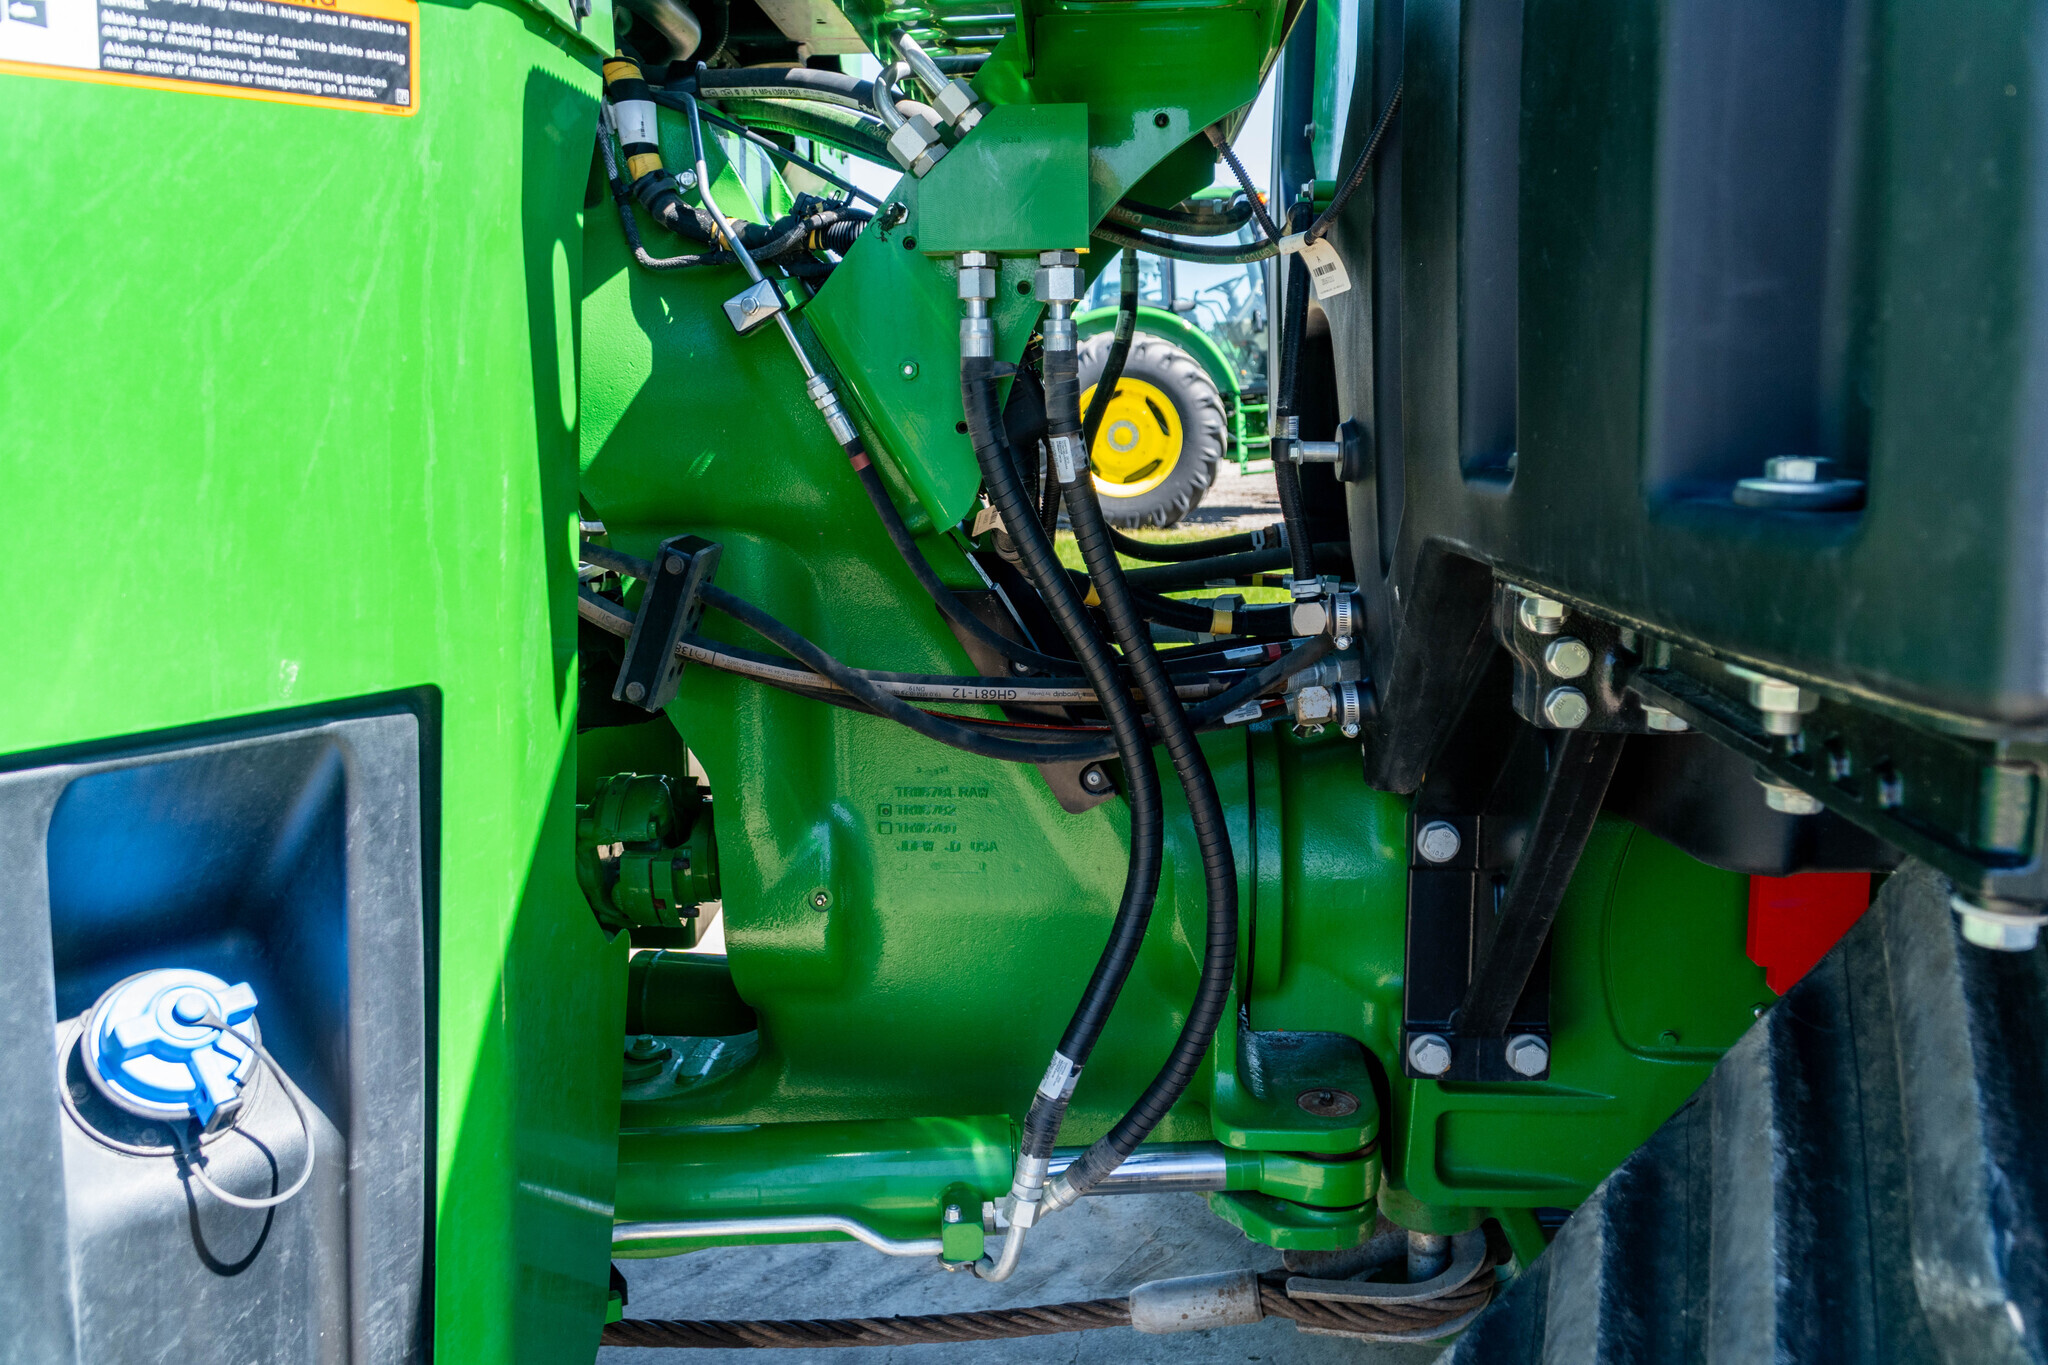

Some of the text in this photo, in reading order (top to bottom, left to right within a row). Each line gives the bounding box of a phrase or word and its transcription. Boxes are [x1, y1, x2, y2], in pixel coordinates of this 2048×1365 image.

[101, 9, 406, 66] Make sure people are clear of machine before starting
[200, 0, 227, 11] may
[228, 0, 264, 15] result
[265, 3, 278, 17] in
[279, 6, 312, 23] hinge
[313, 13, 339, 26] area
[340, 15, 349, 27] if
[350, 18, 395, 34] machine
[396, 24, 407, 36] is
[101, 25, 300, 61] engine or moving steering wheel.
[103, 41, 388, 88] Attach steering lockouts before performing services
[103, 56, 378, 98] near center of machine or transporting on a truck.
[953, 687, 1017, 700] GH681-12
